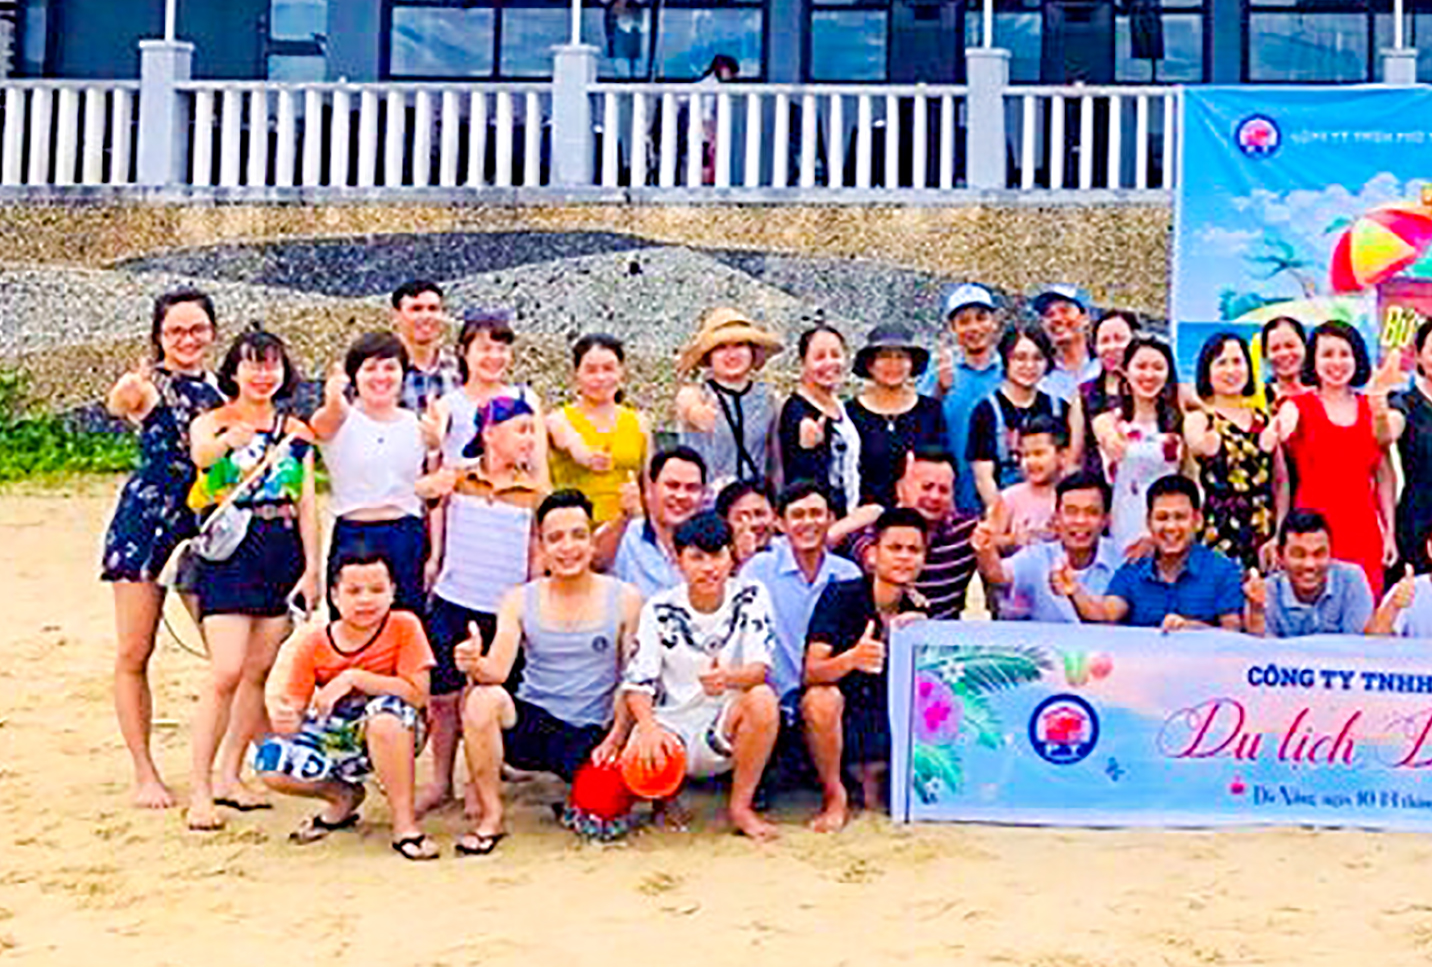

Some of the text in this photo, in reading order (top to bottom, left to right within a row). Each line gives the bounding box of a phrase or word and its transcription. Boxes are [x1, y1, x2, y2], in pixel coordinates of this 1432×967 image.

[1247, 664, 1315, 687] CÔNG
[1319, 669, 1355, 690] TY
[1157, 697, 1263, 761] Du
